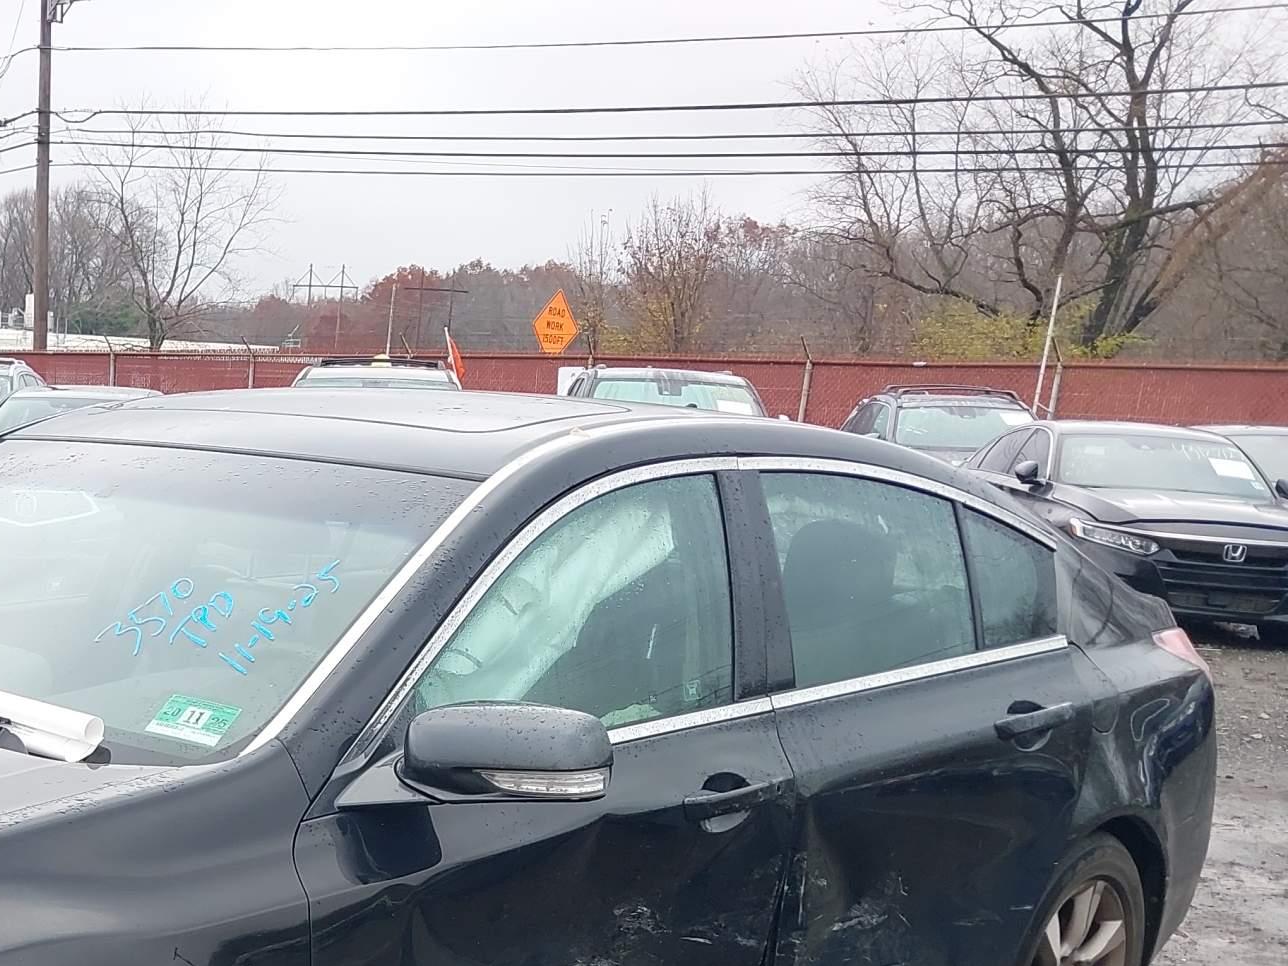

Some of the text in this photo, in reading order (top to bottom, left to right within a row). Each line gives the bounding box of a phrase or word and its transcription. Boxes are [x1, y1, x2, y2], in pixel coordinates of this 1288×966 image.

[548, 306, 566, 318] ROAD
[546, 319, 565, 332] WORK
[183, 709, 205, 726] 11
